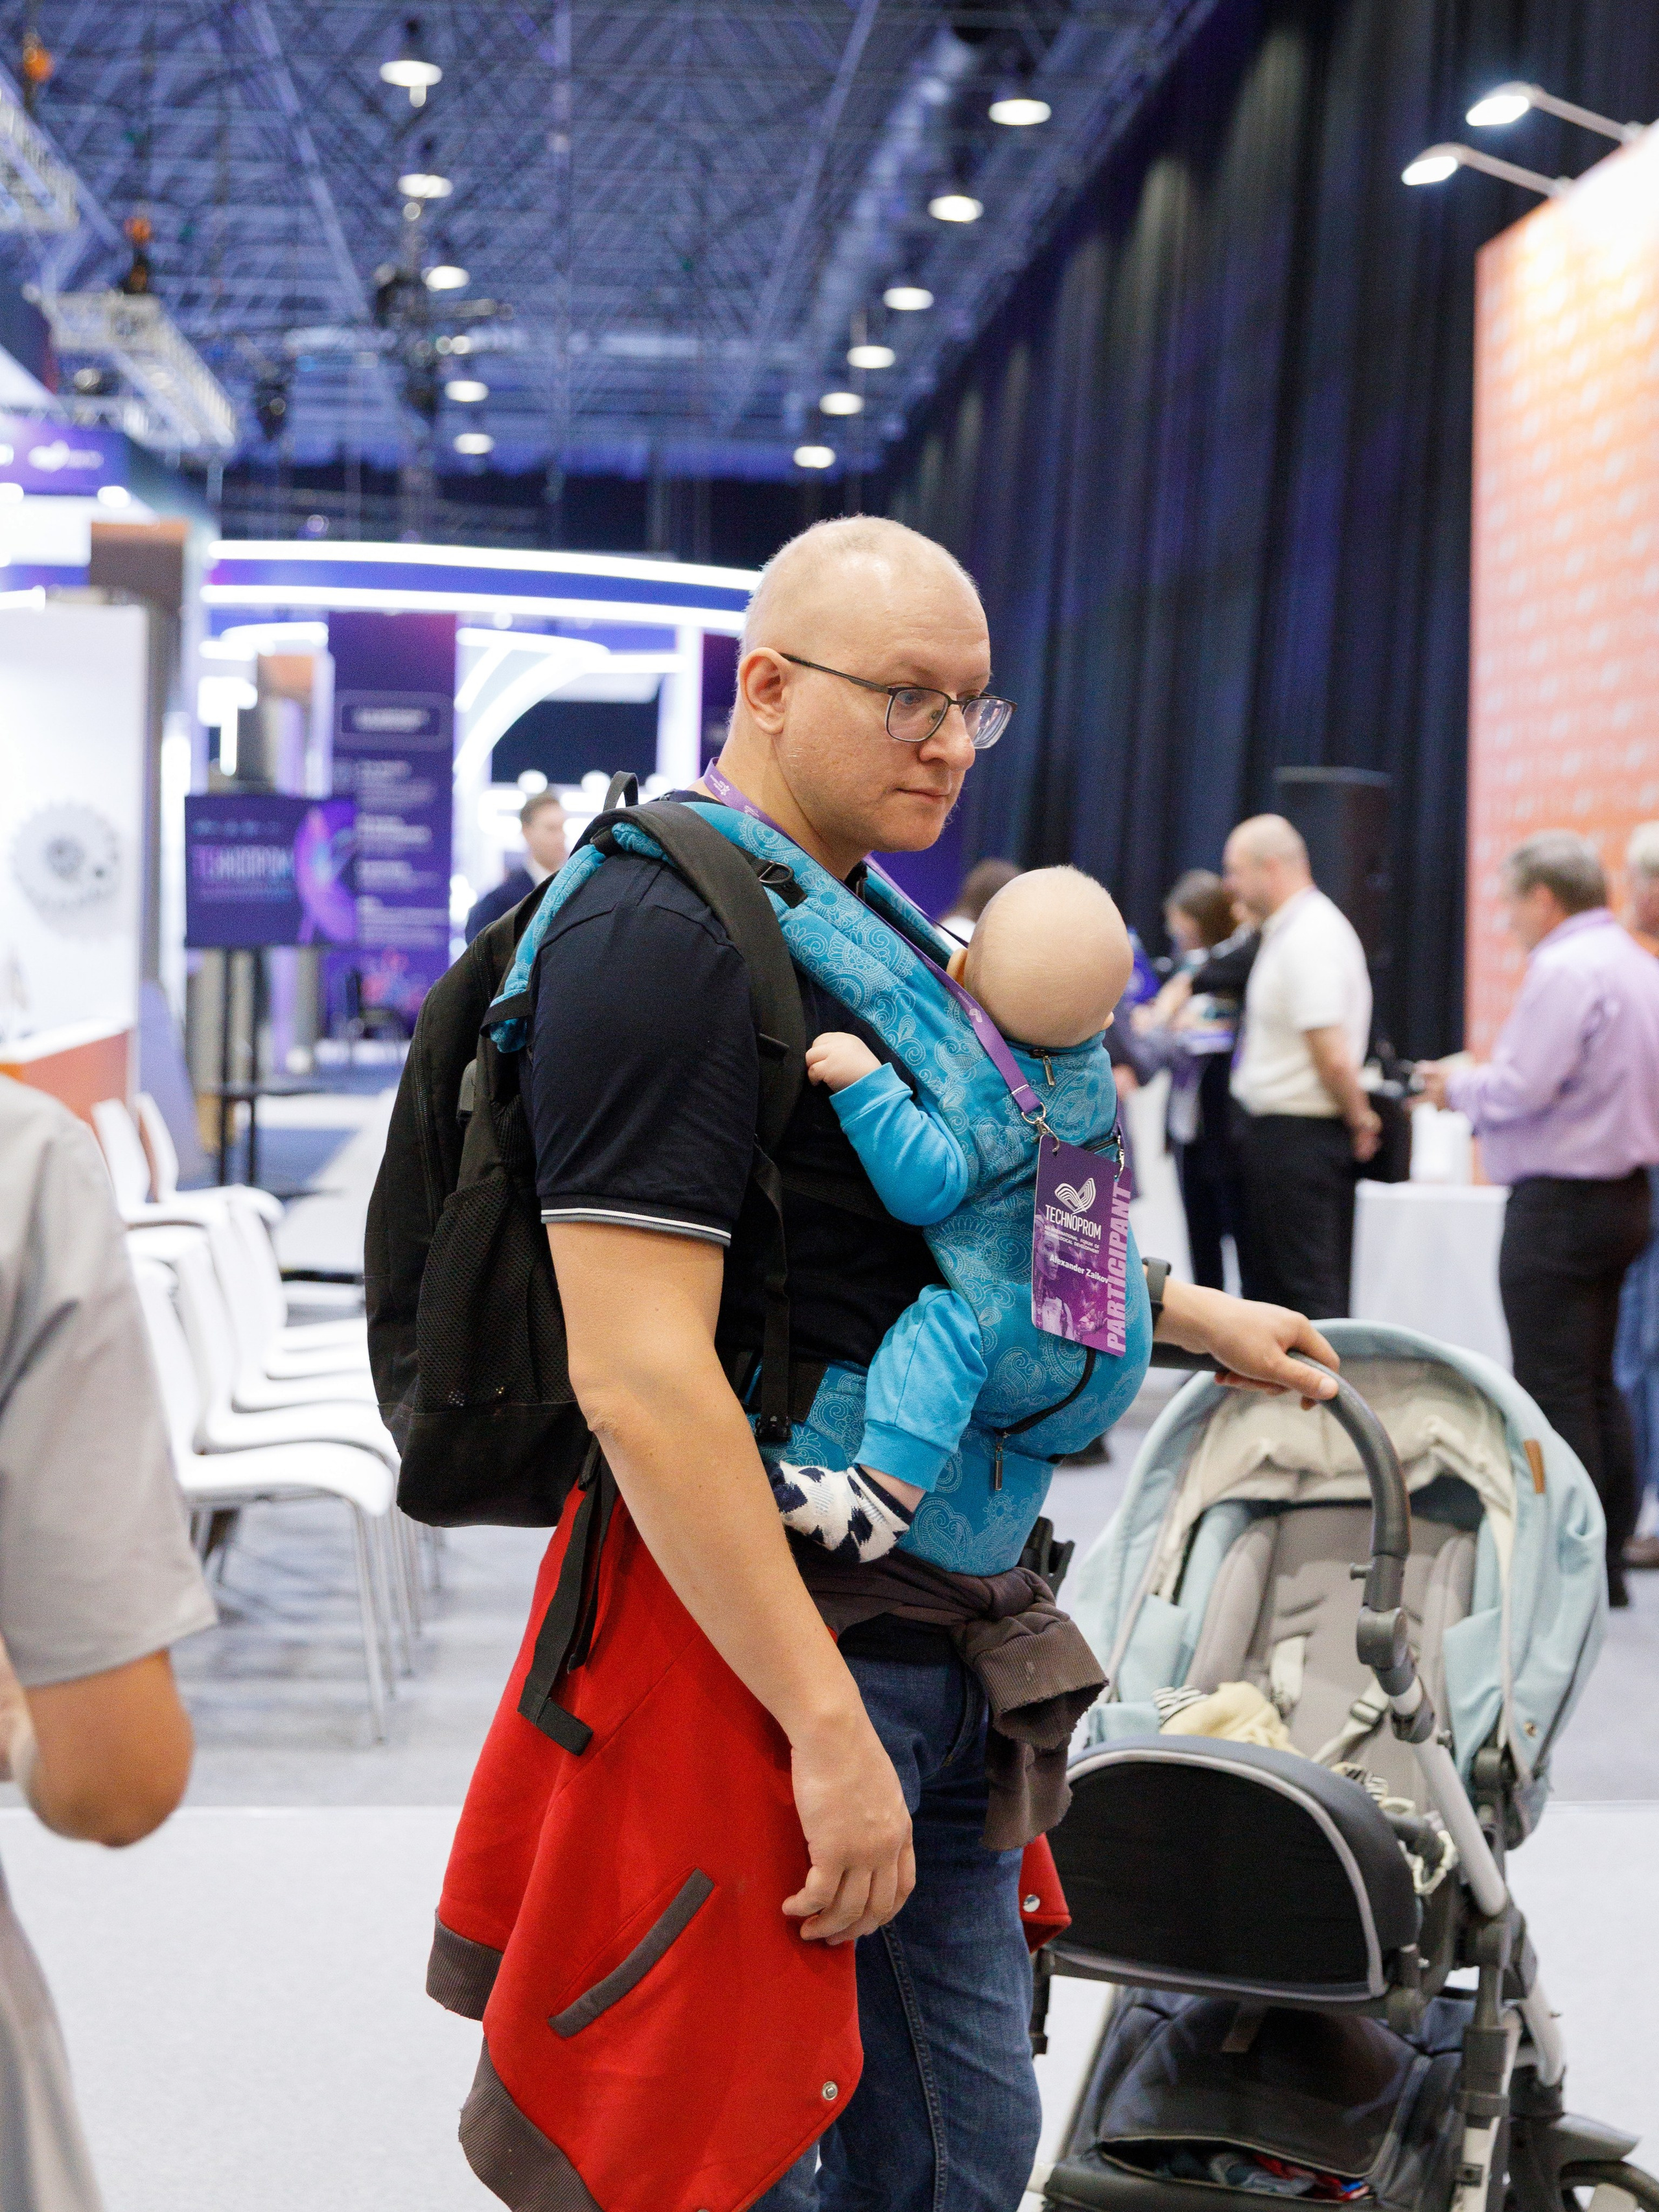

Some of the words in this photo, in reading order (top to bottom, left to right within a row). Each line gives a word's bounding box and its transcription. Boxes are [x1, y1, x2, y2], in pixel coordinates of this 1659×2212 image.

[1045, 1204, 1101, 1240] TECHNOPROM
[1050, 1253, 1085, 1274] Alexander
[1086, 1268, 1109, 1283] Zaikov
[1107, 1182, 1131, 1353] PARTICIPANT
